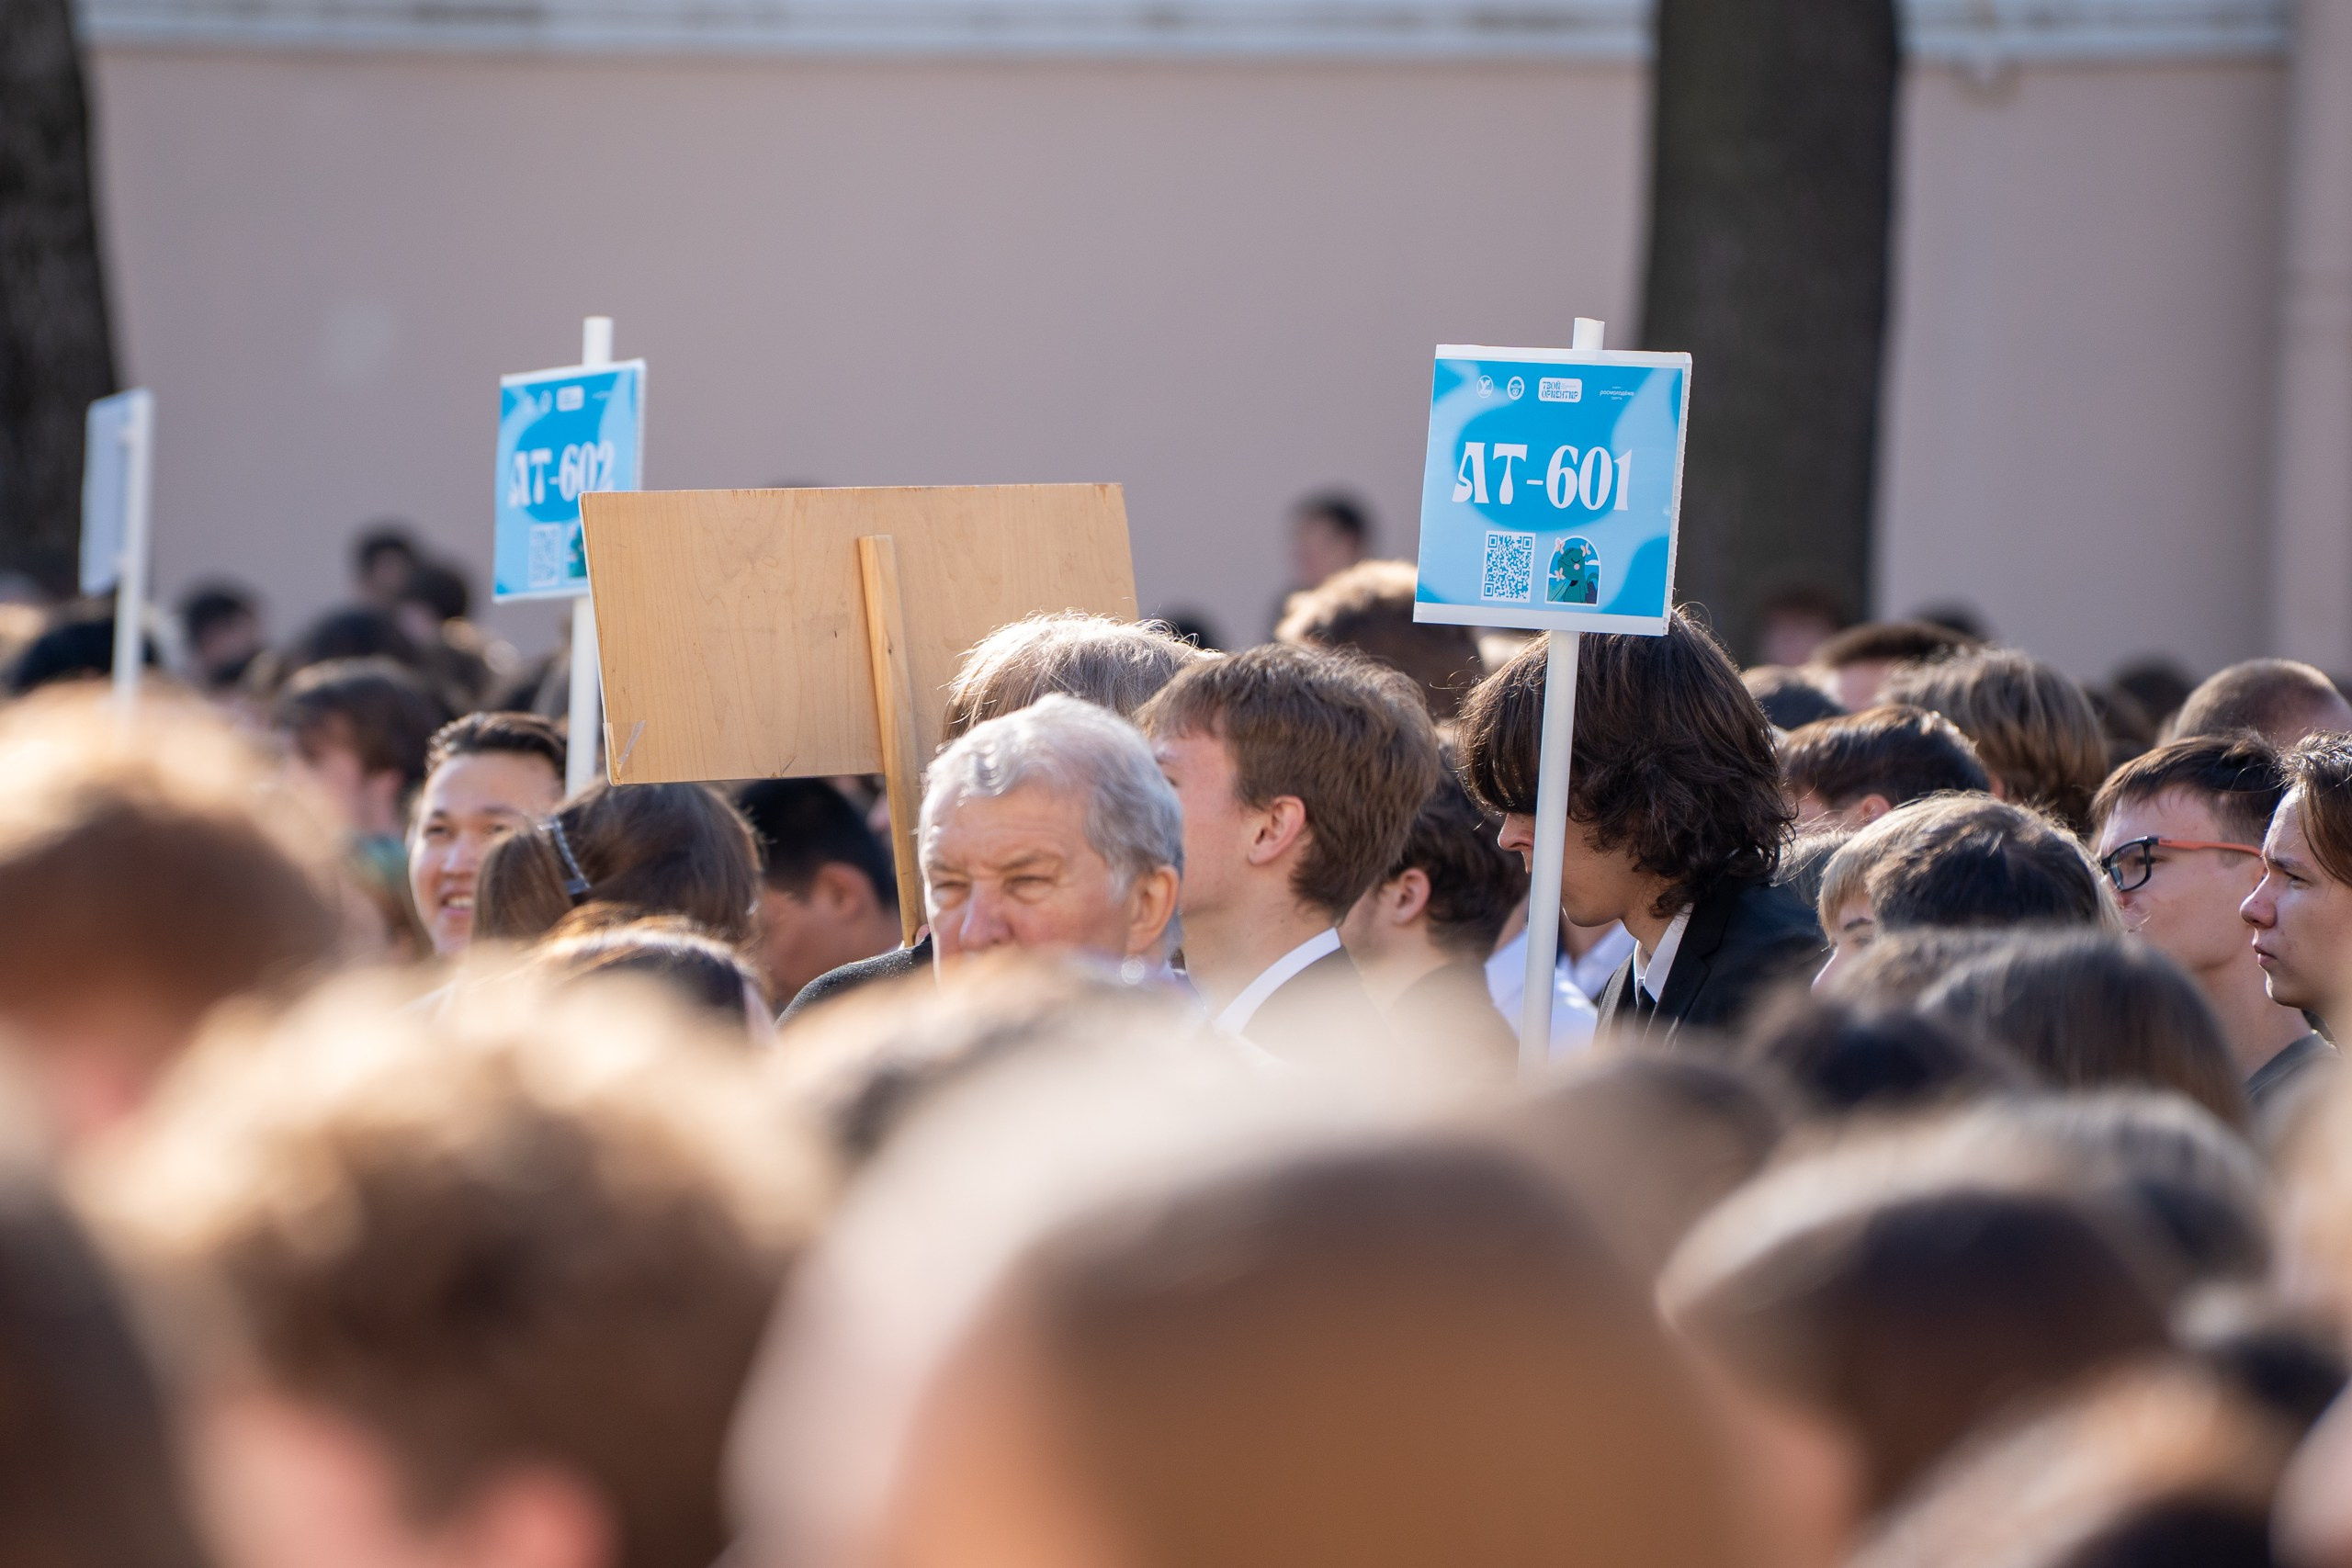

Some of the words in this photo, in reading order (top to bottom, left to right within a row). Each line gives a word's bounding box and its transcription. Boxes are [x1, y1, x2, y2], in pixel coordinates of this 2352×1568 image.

[1541, 389, 1578, 400] ОРИЕНТИР
[1542, 380, 1561, 389] ТВОЙ
[508, 441, 615, 507] АТ-602
[1452, 442, 1633, 511] АТ-601
